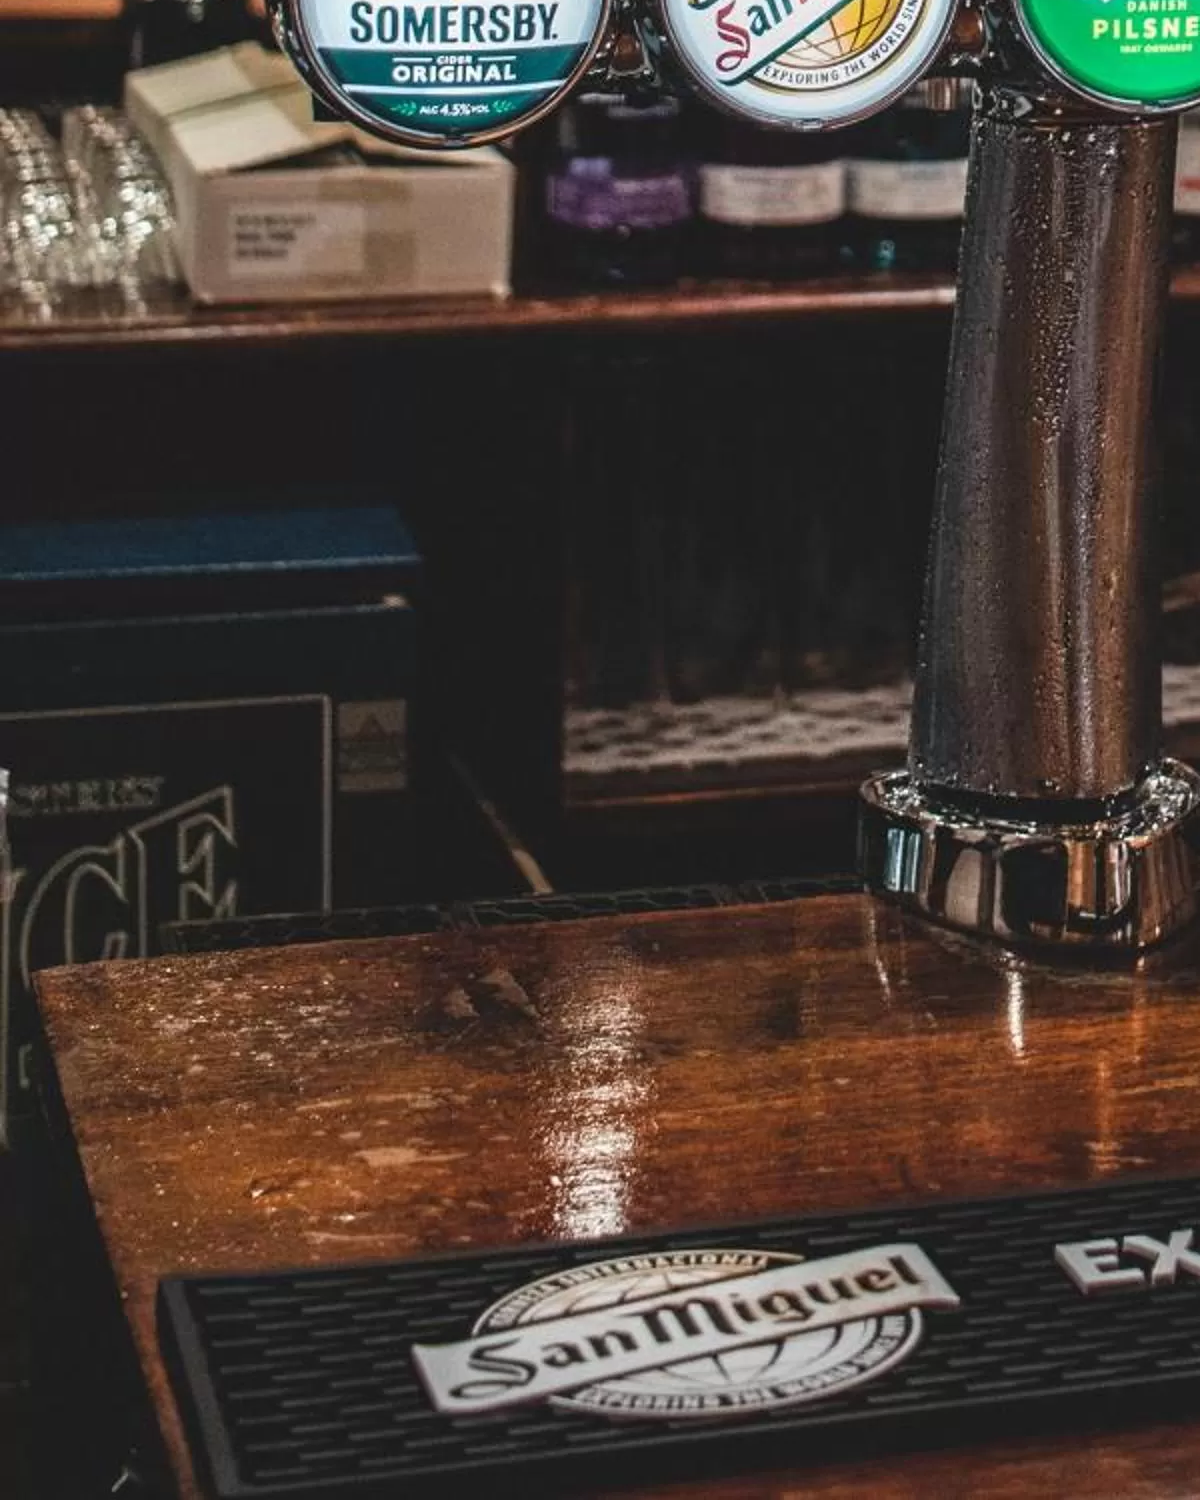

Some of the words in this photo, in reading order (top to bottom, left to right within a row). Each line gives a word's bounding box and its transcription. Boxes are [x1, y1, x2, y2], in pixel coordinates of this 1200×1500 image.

[392, 64, 517, 83] ORIGINAL
[763, 66, 840, 85] EXPLORING
[843, 59, 867, 77] THE
[868, 23, 907, 62] WORLD
[448, 1325, 640, 1400] San
[613, 1253, 925, 1345] Miguel
